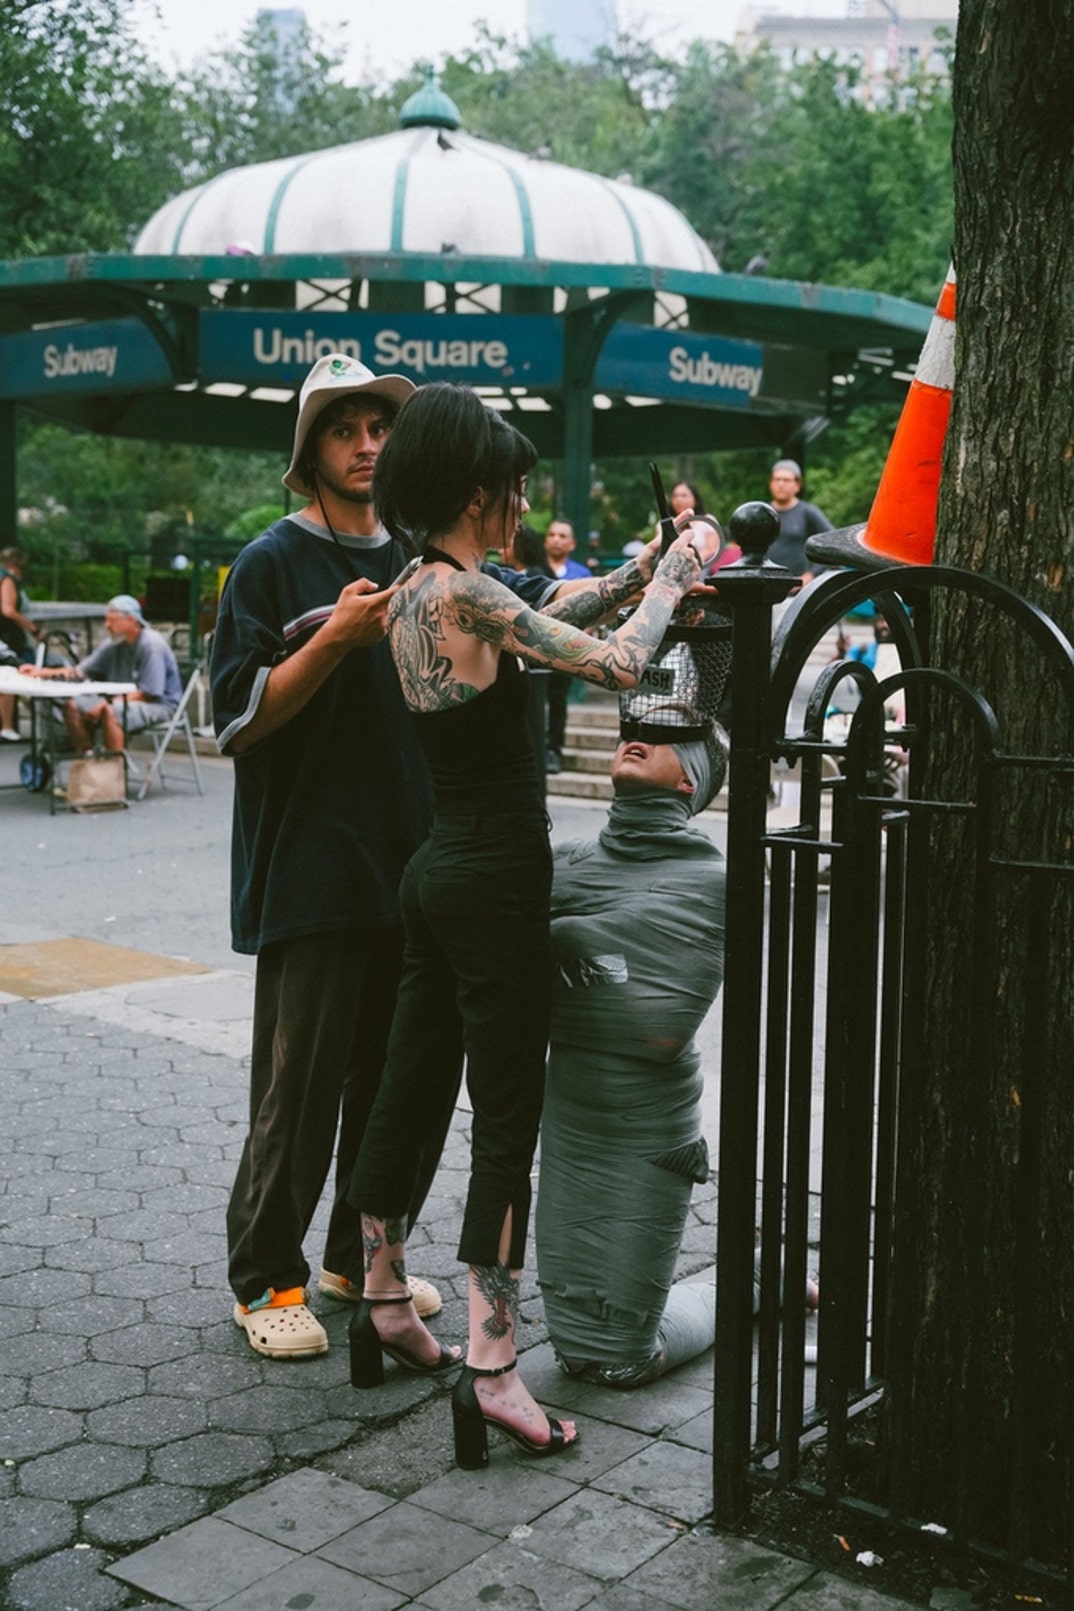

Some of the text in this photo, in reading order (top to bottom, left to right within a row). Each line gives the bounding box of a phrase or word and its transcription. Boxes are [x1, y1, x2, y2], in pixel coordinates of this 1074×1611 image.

[43, 342, 118, 378] Subway
[254, 328, 509, 373] Union Square
[669, 346, 763, 397] Subway
[640, 669, 670, 690] ASH
